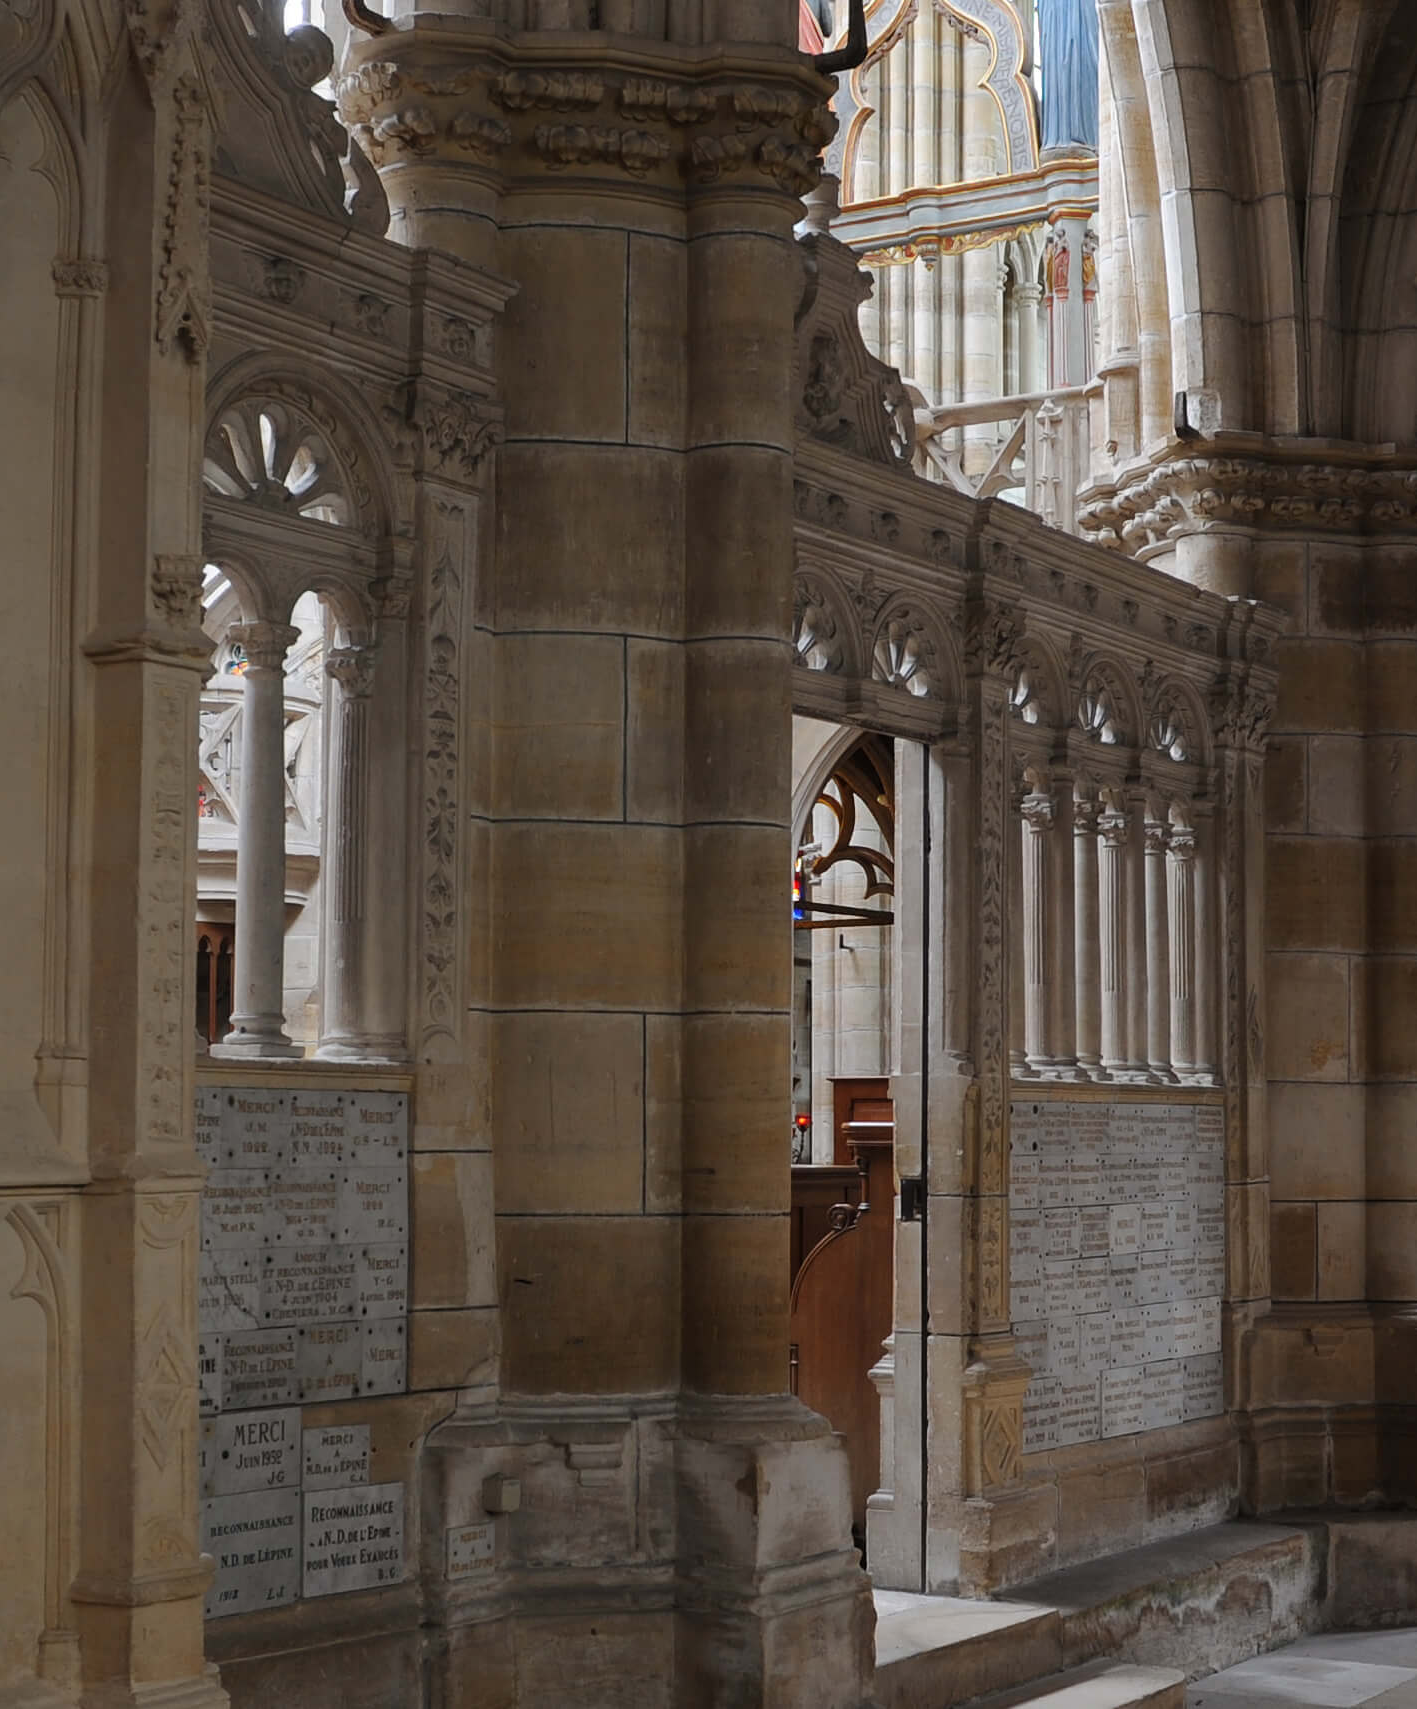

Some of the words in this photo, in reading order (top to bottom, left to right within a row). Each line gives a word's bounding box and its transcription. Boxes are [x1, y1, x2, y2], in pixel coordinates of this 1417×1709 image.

[1006, 100, 1029, 171] NOBIS
[237, 1099, 276, 1114] MERCI
[360, 1108, 394, 1124] MERCI
[356, 1181, 391, 1194] MERCI
[277, 1264, 356, 1278] RECONNAISSANCE
[367, 1258, 399, 1271] MERCI
[310, 1328, 349, 1345] MERCI
[224, 1341, 295, 1357] RECONNAISSANCE
[234, 1419, 285, 1446] MERCI
[321, 1434, 353, 1446] MERCI
[235, 1453, 260, 1470] JUIN
[311, 1501, 394, 1523] RECONNAISSANCE
[210, 1515, 294, 1537] RECONNAISSANCE
[243, 1554, 256, 1565] DE
[307, 1557, 329, 1571] POUR
[359, 1547, 399, 1564] EXAUCÉS
